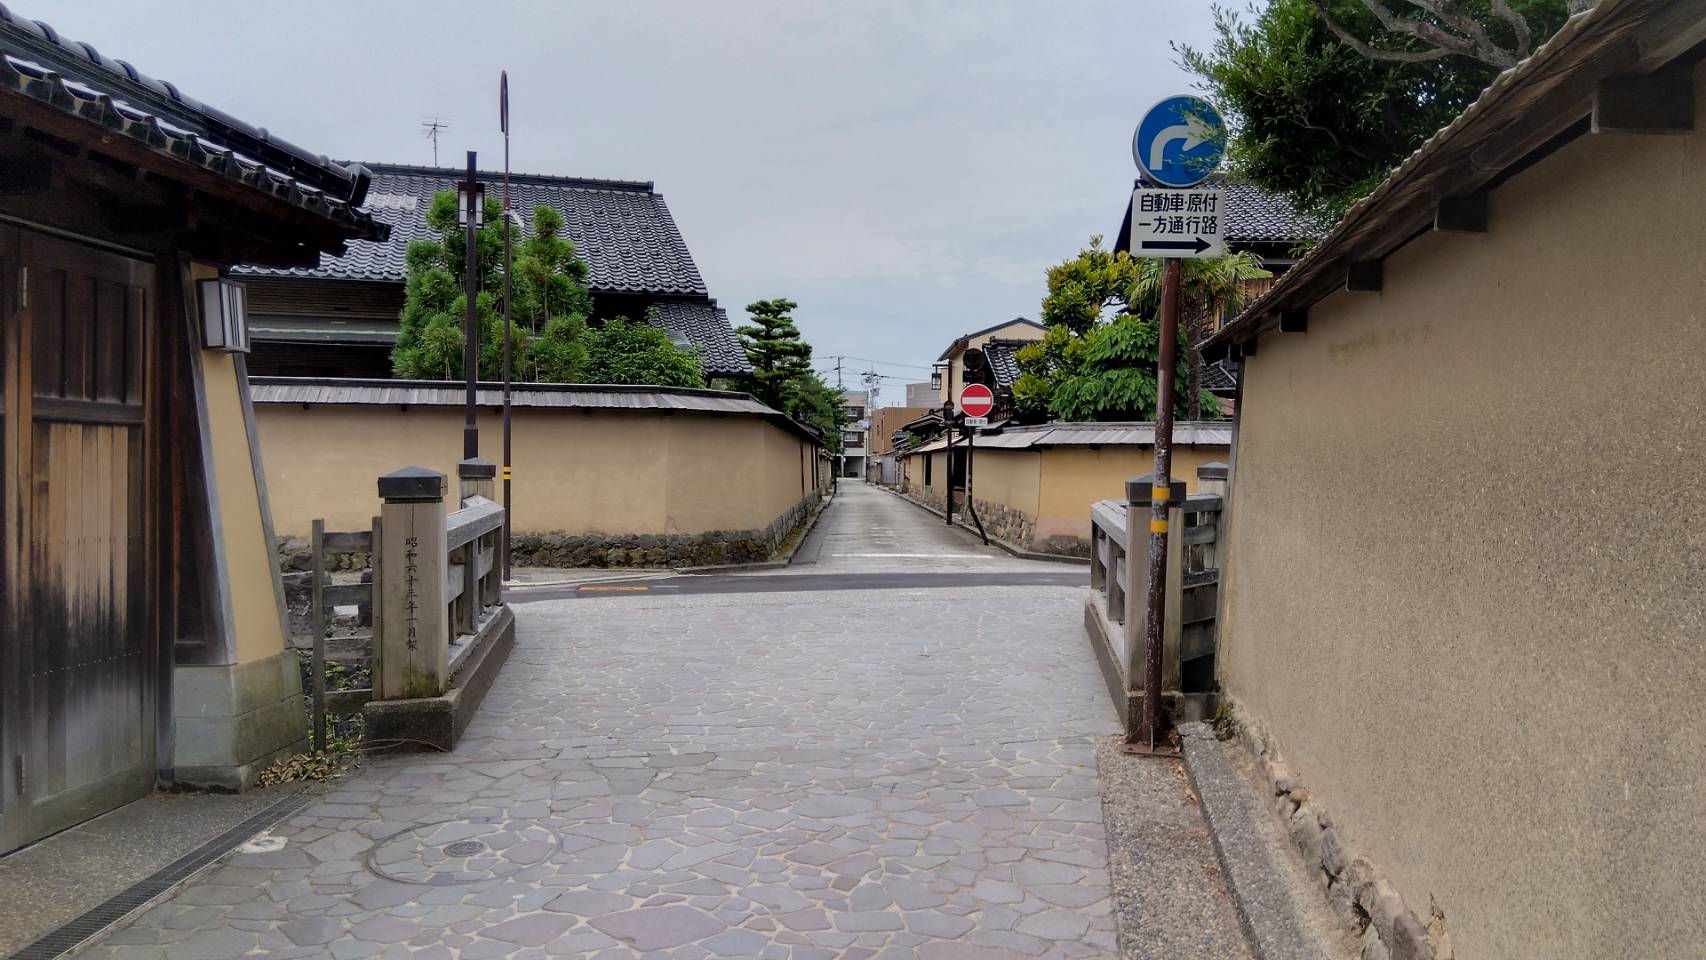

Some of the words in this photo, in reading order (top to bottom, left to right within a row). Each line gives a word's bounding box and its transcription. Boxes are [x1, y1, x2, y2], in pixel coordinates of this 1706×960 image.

[1138, 215, 1218, 235] 一方通行路
